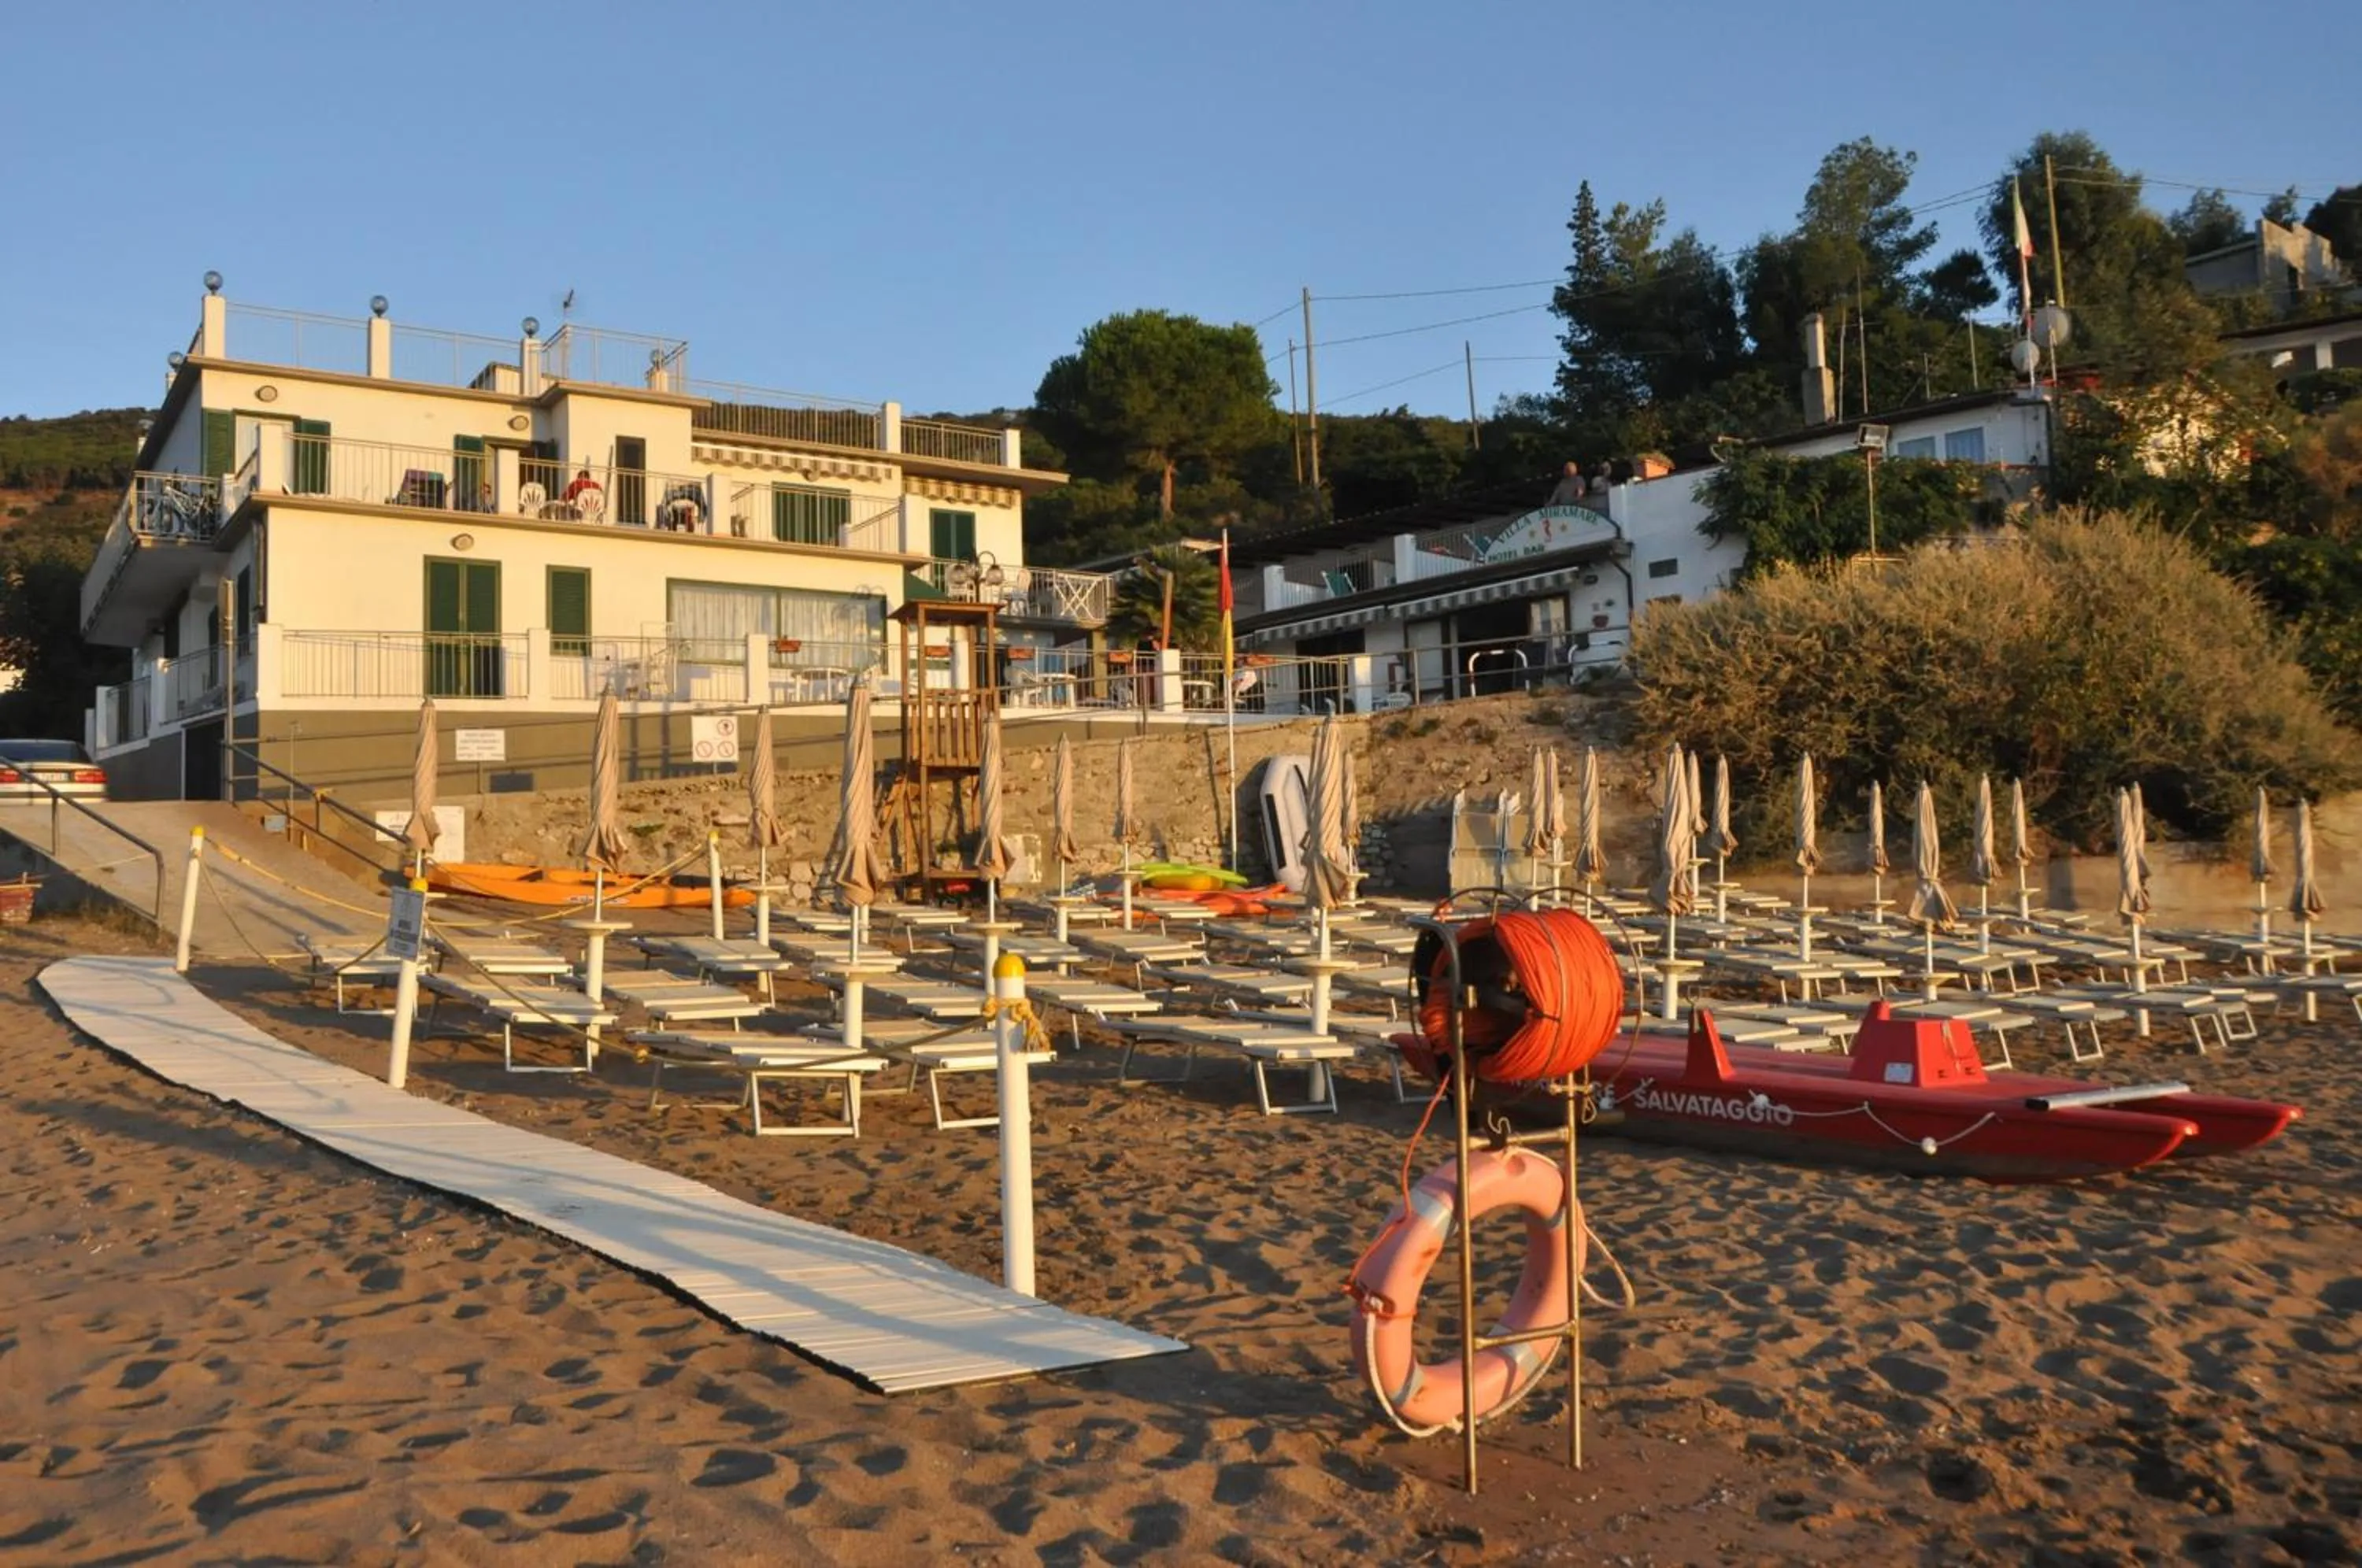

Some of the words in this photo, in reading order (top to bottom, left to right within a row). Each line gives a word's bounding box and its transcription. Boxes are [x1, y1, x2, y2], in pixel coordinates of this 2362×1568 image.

[1499, 516, 1531, 543] VILLA
[1539, 505, 1597, 525] MIRAMARE
[1488, 549, 1517, 562] HOTEL
[1524, 543, 1545, 555] BAR
[1634, 1089, 1794, 1126] SALVATAGGIO
